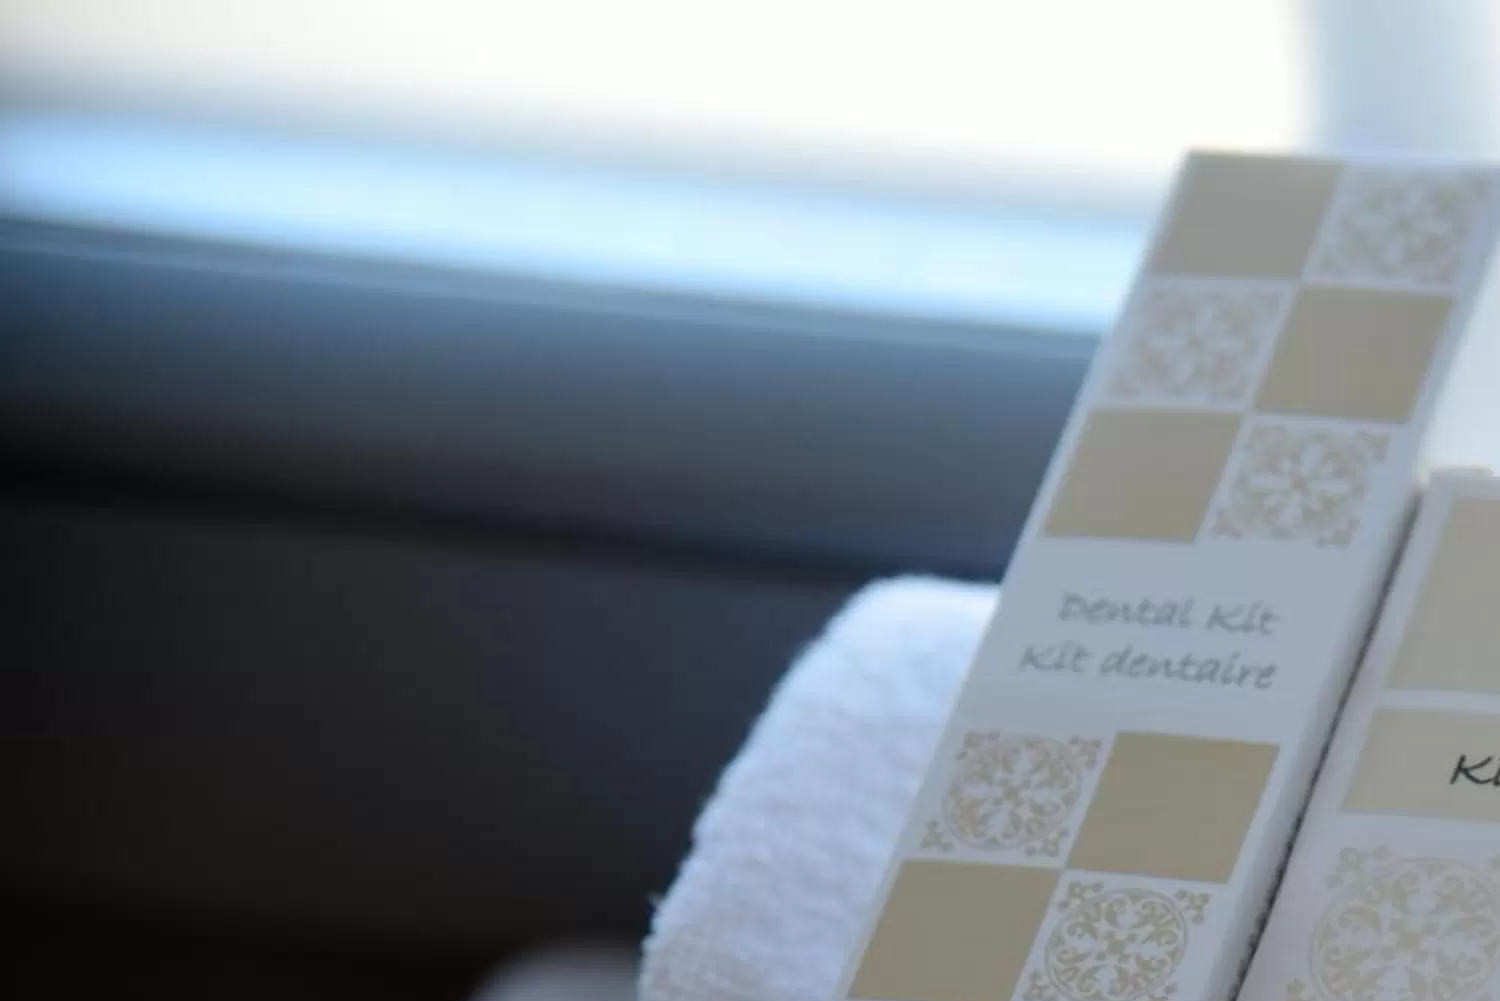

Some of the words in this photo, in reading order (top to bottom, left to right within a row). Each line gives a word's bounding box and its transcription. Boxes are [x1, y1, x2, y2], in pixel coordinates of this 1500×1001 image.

[1058, 592, 1195, 629] Dental
[1205, 598, 1281, 635] Kit
[1018, 640, 1090, 673] Kit
[1099, 643, 1276, 689] dentaire
